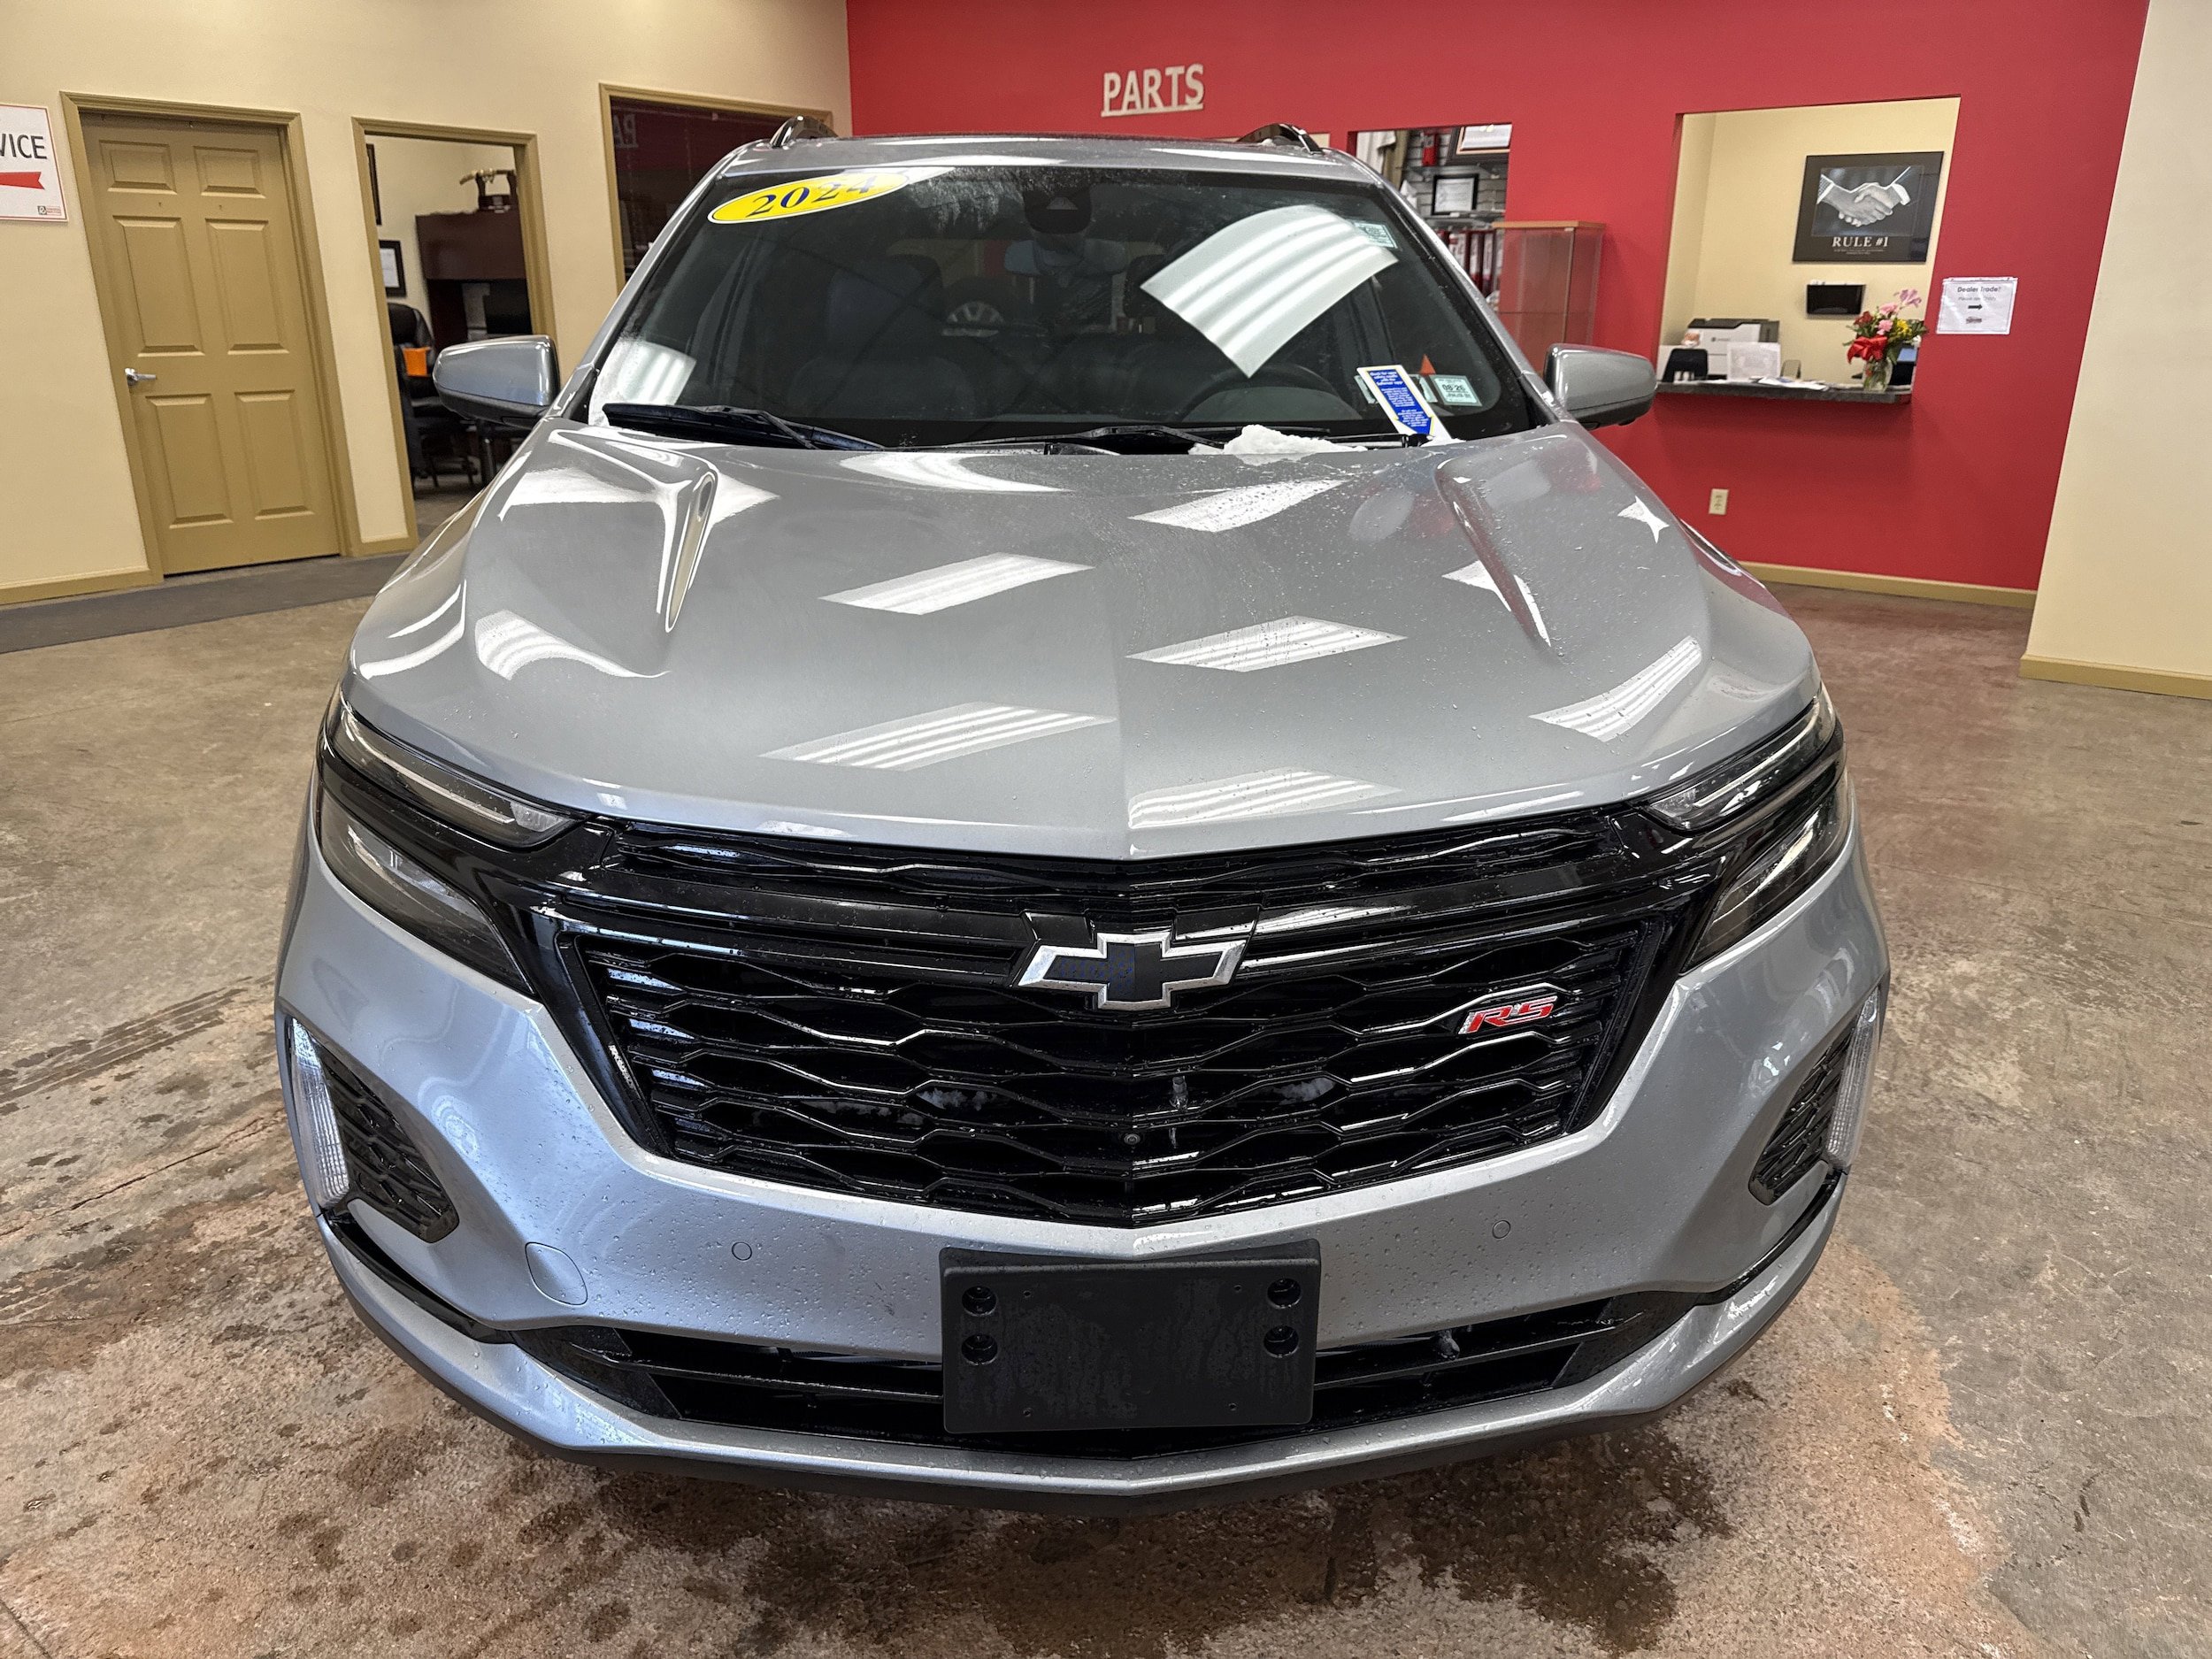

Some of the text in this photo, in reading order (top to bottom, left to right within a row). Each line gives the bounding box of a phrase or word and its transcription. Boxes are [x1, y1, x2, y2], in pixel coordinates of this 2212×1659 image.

[1102, 63, 1204, 113] PARTS
[746, 175, 878, 218] 2024
[1832, 236, 1889, 247] RULE #1
[1458, 995, 1557, 1034] RS
